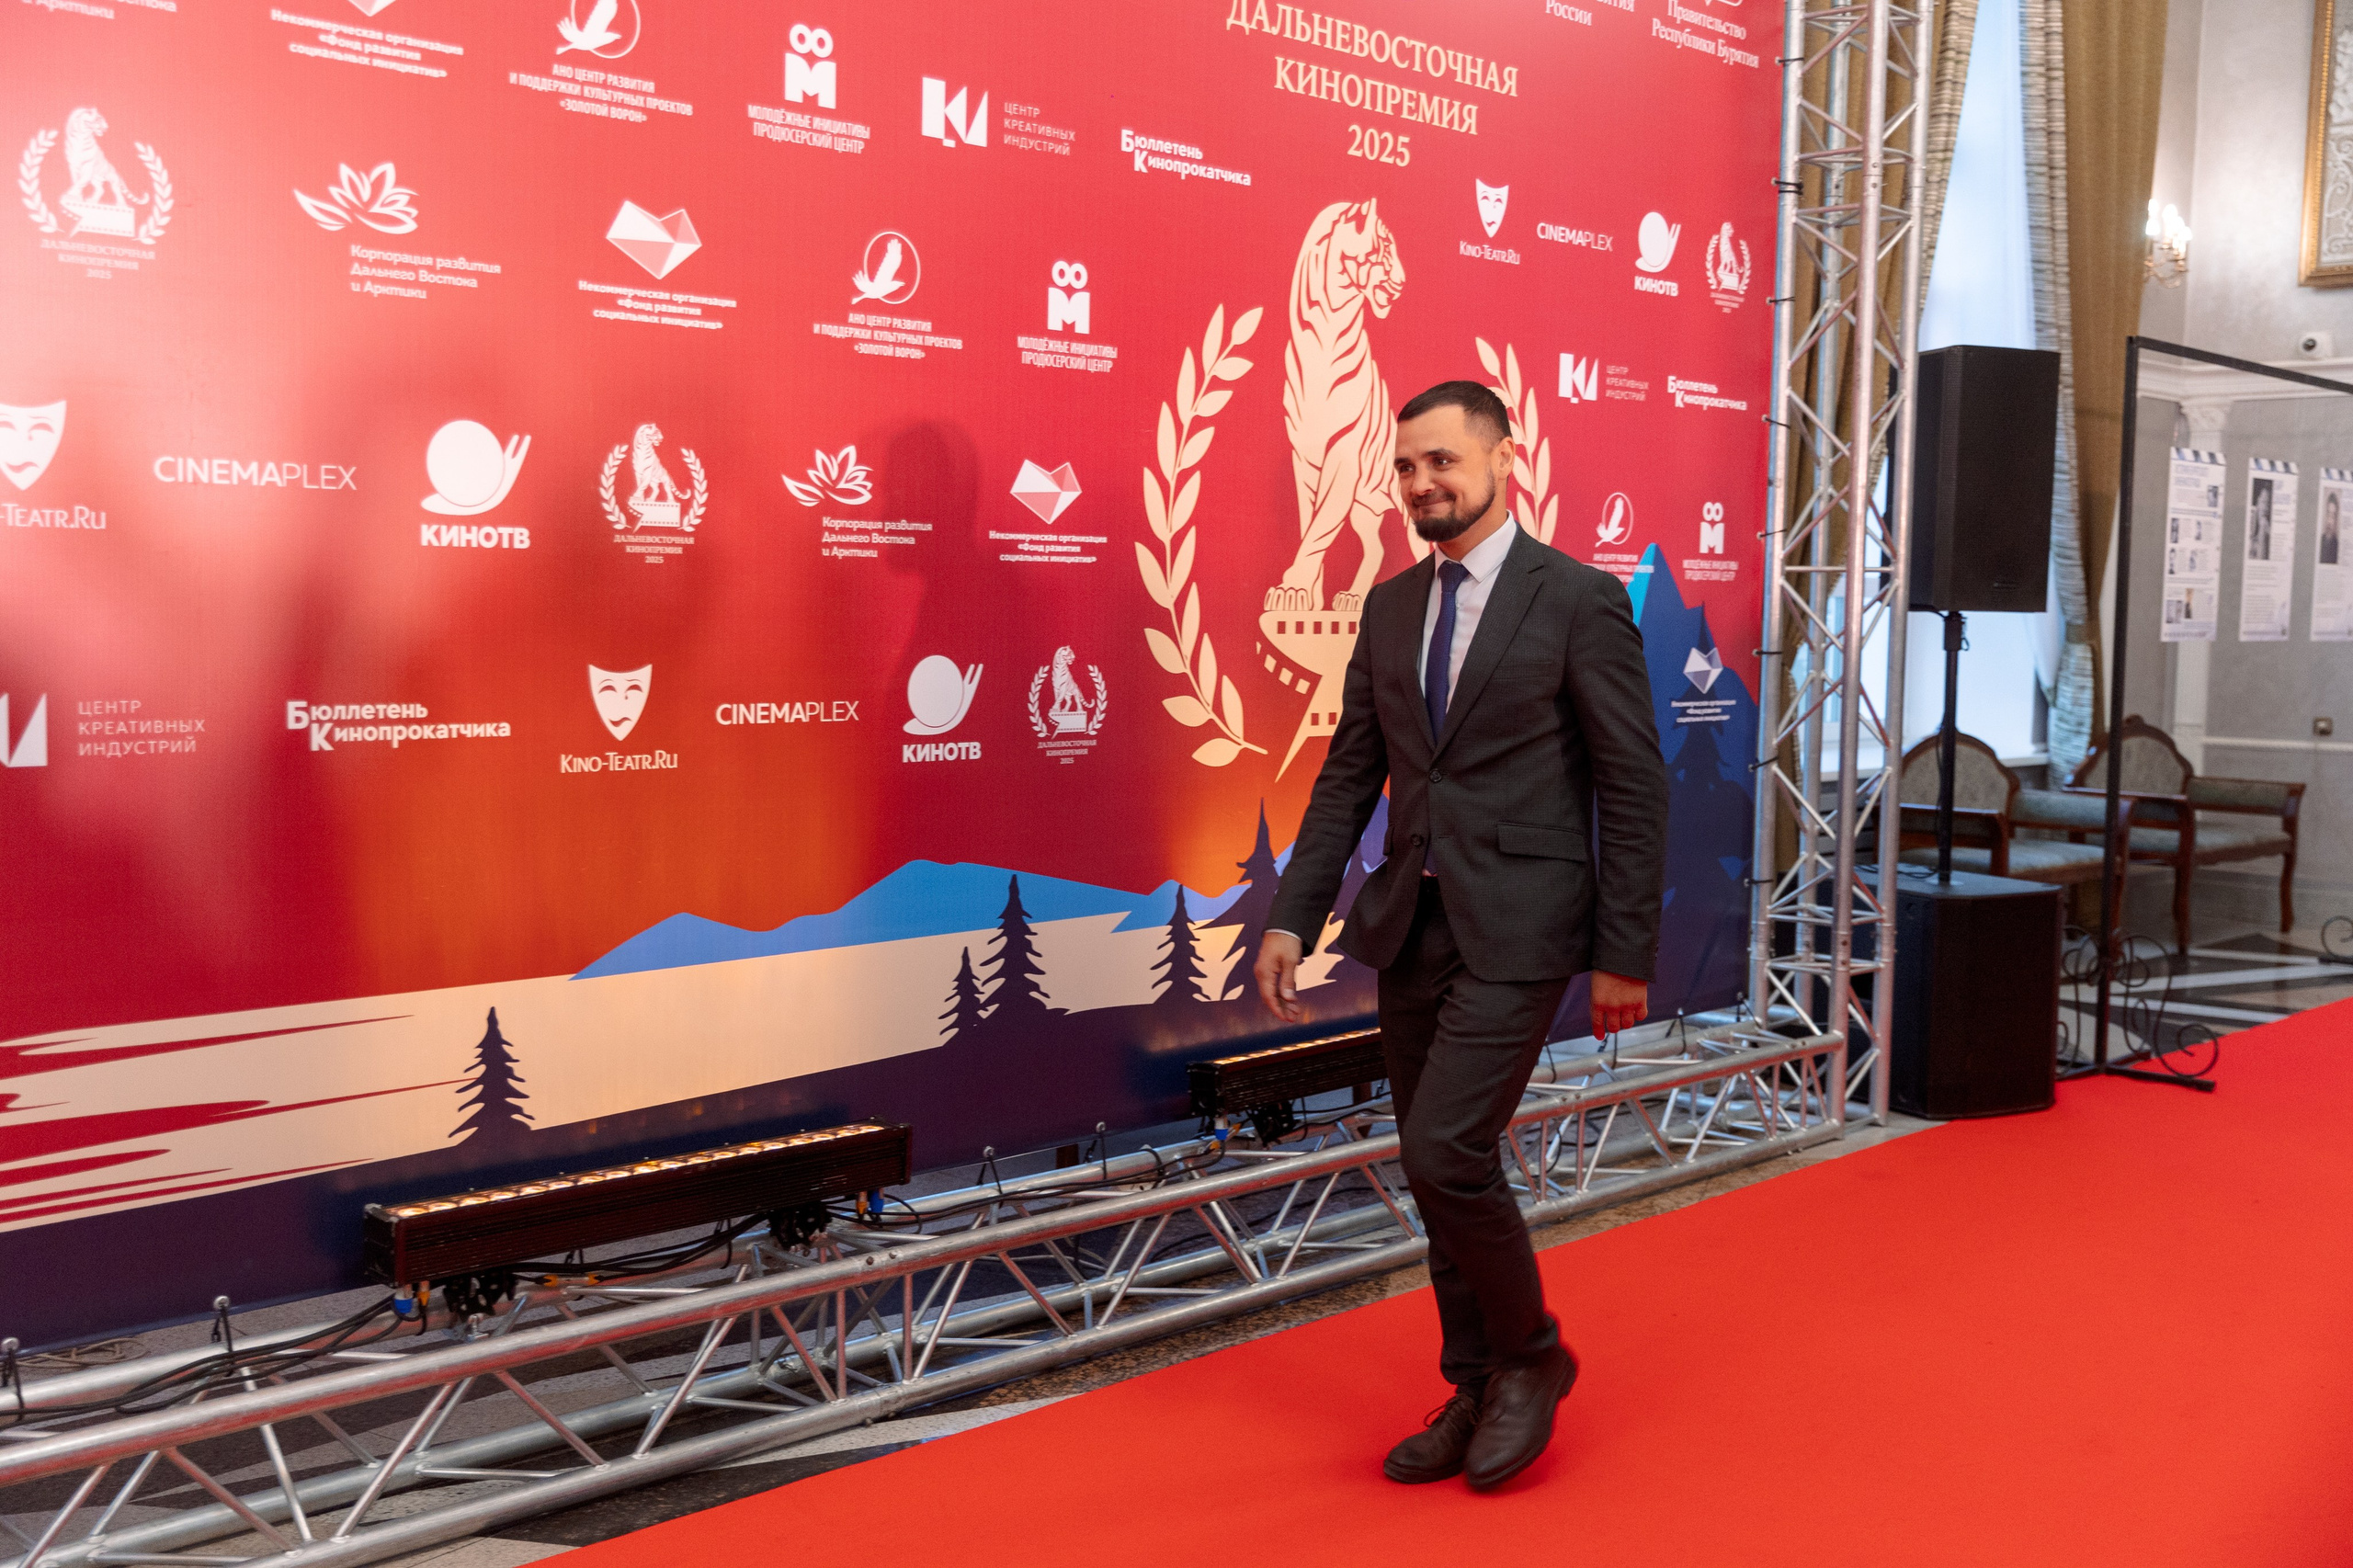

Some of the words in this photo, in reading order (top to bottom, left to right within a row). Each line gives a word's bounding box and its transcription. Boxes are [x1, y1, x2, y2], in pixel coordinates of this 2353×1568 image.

[271, 9, 383, 40] Некоммерческая
[385, 33, 463, 55] организация
[1667, 0, 1746, 40] Правительство
[319, 34, 362, 51] «Фонд
[364, 43, 421, 61] развития
[1226, 0, 1518, 97] ДАЛЬНЕВОСТОЧНАЯ
[1652, 17, 1716, 54] Республики
[1717, 39, 1759, 69] Бурятия
[290, 42, 370, 65] социальных
[372, 58, 447, 77] инициатив»
[552, 64, 574, 78] АНО
[574, 68, 606, 84] ЦЕНТР
[607, 74, 655, 93] РАЗВИТИЯ
[509, 72, 517, 84] И
[519, 74, 582, 96] ПОДДЕРЖКИ
[584, 85, 645, 108] КУЛЬТУРНЫХ
[646, 97, 693, 116] ПРОЕКТОВ
[1274, 56, 1478, 135] КИНОПРЕМИЯ
[560, 98, 608, 117] «ЗОЛОТОЙ
[610, 107, 647, 123] ВОРОН»
[1004, 102, 1040, 118] ЦЕНТР
[754, 122, 833, 149] ПРОДЮСЕРСКИЙ
[834, 137, 865, 154] ЦЕНТР
[813, 117, 870, 139] ИНИЦИАТИВЫ
[1004, 119, 1075, 142] КРЕАТИВНЫХ
[1004, 134, 1070, 155] ИНДУСТРИЙ
[1120, 129, 1203, 160] Бюллетень
[1347, 124, 1410, 167] 2025
[1134, 150, 1251, 186] Кинопрокатчика
[40, 238, 155, 260] ДАЛЬНЕВОСТОЧНАЯ
[1537, 222, 1613, 252] CINEMAPLEX
[58, 253, 139, 270] КИНОПРЕМИЯ
[350, 244, 433, 266] Корпорация
[436, 256, 502, 274] развития
[350, 263, 415, 280] Дальнего
[418, 269, 478, 288] Востока
[1634, 276, 1678, 297] КИНОТВ
[350, 281, 360, 291] и
[363, 280, 426, 299] Арктики
[578, 280, 670, 300] Некоммерческая
[672, 292, 737, 308] организация
[593, 309, 660, 324] социальных
[654, 303, 701, 316] развития
[847, 312, 866, 324] АНО
[867, 315, 892, 328] ЦЕНТР
[892, 317, 932, 332] РАЗВИТИЯ
[821, 324, 871, 338] ПОДДЕРЖКИ
[873, 330, 923, 346] КУЛЬТУРНЫХ
[924, 335, 962, 349] ПРОЕКТОВ
[1087, 358, 1113, 373] ЦЕНТР
[1667, 375, 1718, 394] Бюллетень
[1675, 391, 1747, 411] Кинопрокатчика
[153, 456, 357, 490] CINEMAPLEX
[421, 524, 530, 549] КИНОТВ
[823, 517, 882, 531] Корпорация
[884, 519, 933, 532] развития
[822, 531, 870, 542] Дальнего
[871, 533, 915, 544] Востока
[831, 546, 878, 559] Арктики
[78, 700, 142, 716] ЦЕНТР
[287, 700, 428, 730] Бюллетень
[715, 700, 859, 725] CINEMAPLEX
[78, 719, 205, 735] КРЕАТИВНЫХ
[310, 722, 511, 751] Кинопрокатчика
[78, 735, 197, 757] ИНДУСТРИЙ
[903, 742, 982, 763] КИНОТВ
